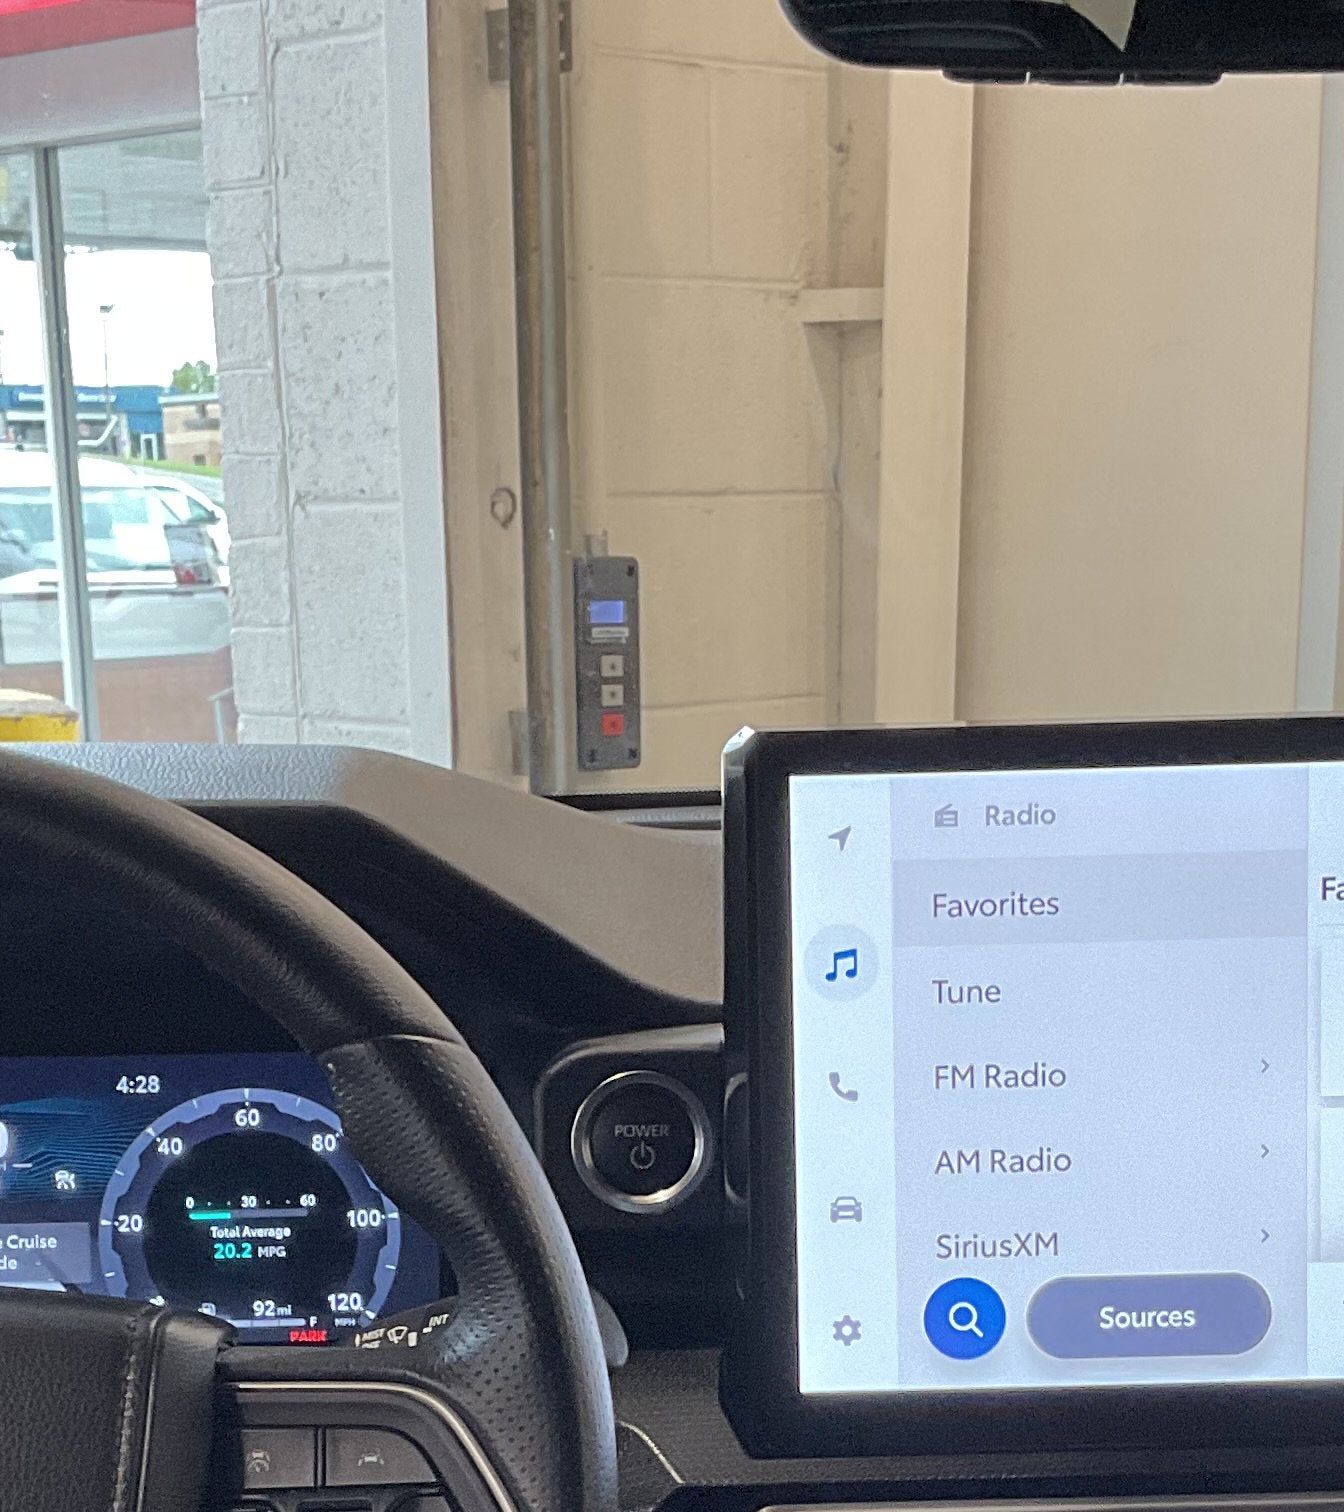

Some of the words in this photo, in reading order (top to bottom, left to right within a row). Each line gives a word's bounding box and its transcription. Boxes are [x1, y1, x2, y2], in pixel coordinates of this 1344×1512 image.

[984, 803, 1057, 828] Radio
[932, 891, 1060, 918] Favorites
[932, 979, 1002, 1004] Tune
[115, 1074, 161, 1095] 4:28
[934, 1065, 976, 1090] FM
[984, 1061, 1067, 1089] Radio
[235, 1108, 260, 1127] 60
[614, 1124, 670, 1137] POWER
[158, 1137, 183, 1156] 40
[311, 1133, 338, 1152] 80
[935, 1150, 981, 1175] AM
[990, 1146, 1072, 1174] Radio
[186, 1196, 195, 1209] 0
[241, 1195, 256, 1208] 30
[300, 1194, 317, 1207] 60
[119, 1214, 143, 1233] 20
[347, 1210, 381, 1228] 100
[7, 1234, 58, 1250] Cruise
[210, 1226, 240, 1239] Total
[242, 1226, 291, 1240] Average
[214, 1243, 253, 1260] 20.2
[258, 1246, 287, 1258] MPG
[936, 1232, 1059, 1259] SiriusXM
[328, 1293, 362, 1312] 120
[1099, 1305, 1196, 1330] Sources
[289, 1328, 328, 1342] PARK
